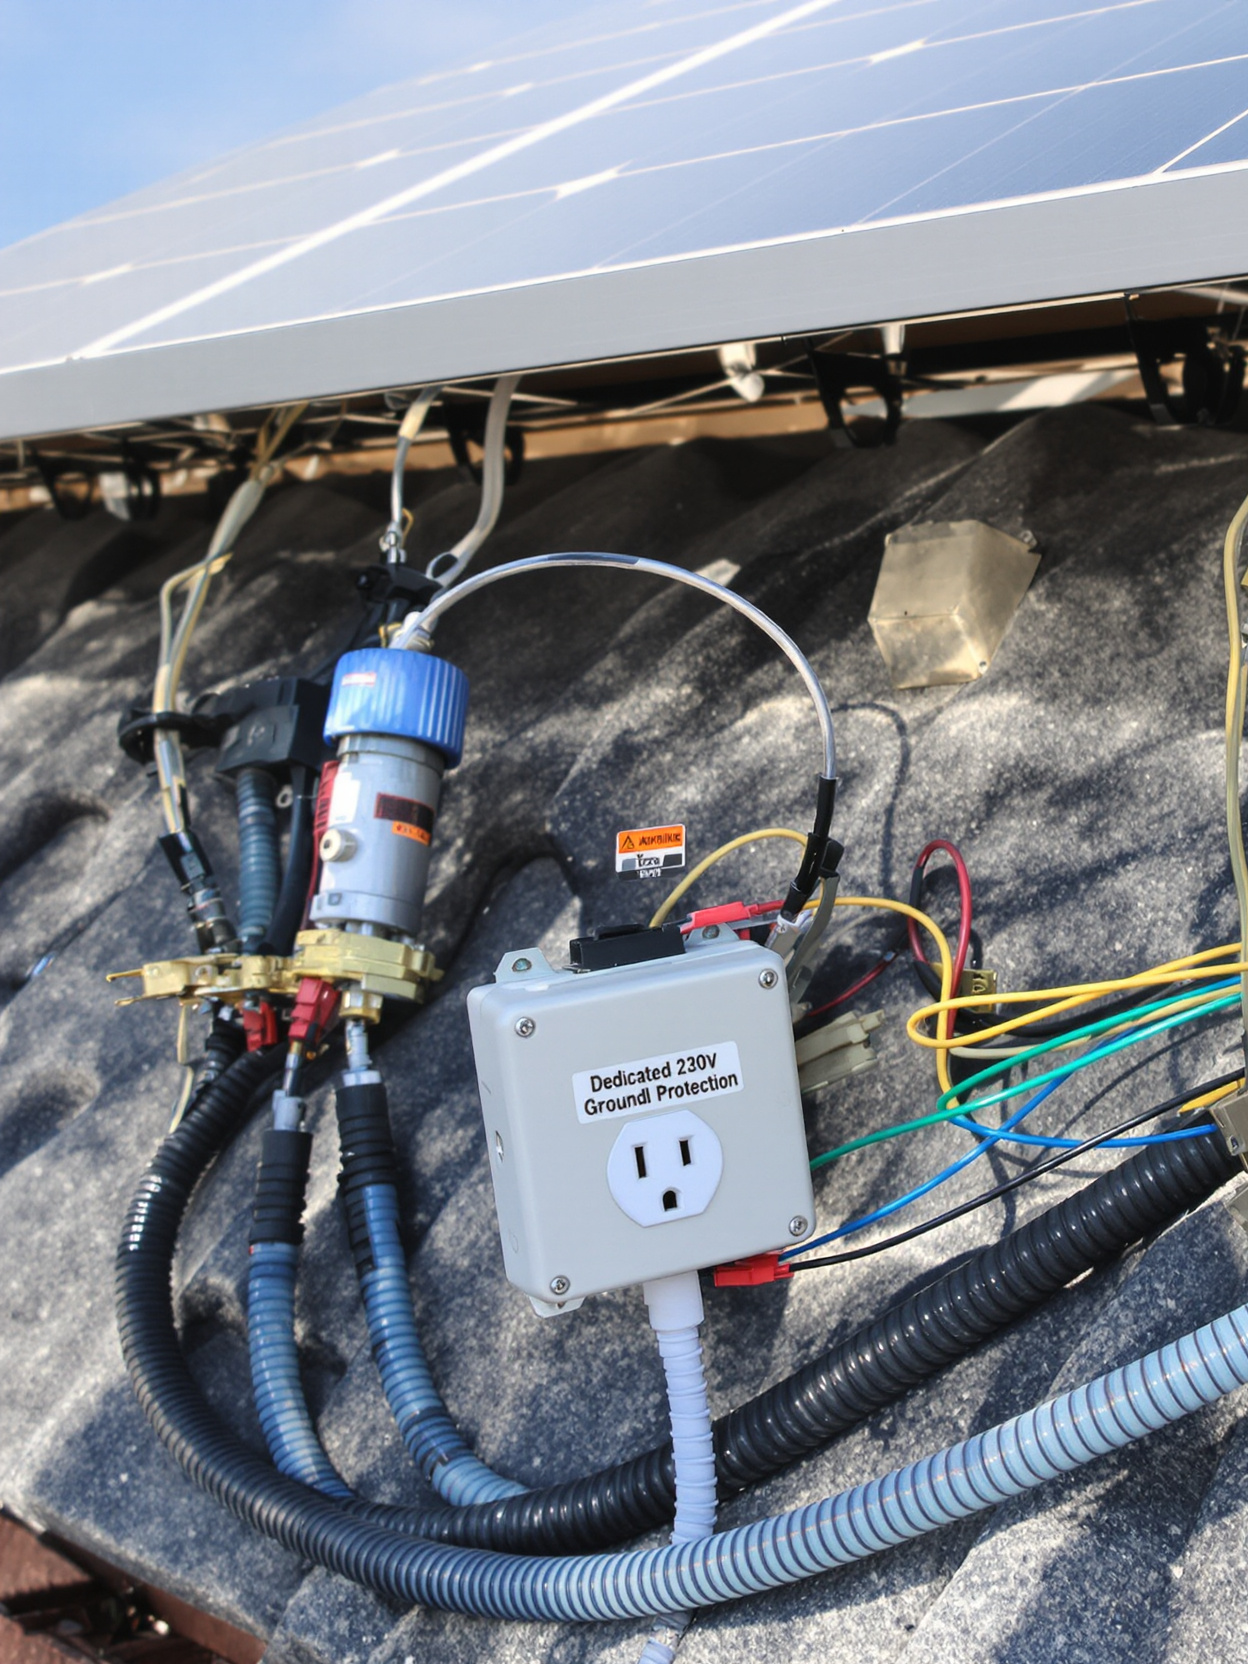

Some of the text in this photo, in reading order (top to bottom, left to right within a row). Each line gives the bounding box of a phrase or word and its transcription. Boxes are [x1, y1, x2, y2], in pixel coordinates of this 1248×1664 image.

[590, 1052, 718, 1093] Dedicated 230V
[656, 1073, 739, 1102] Protection
